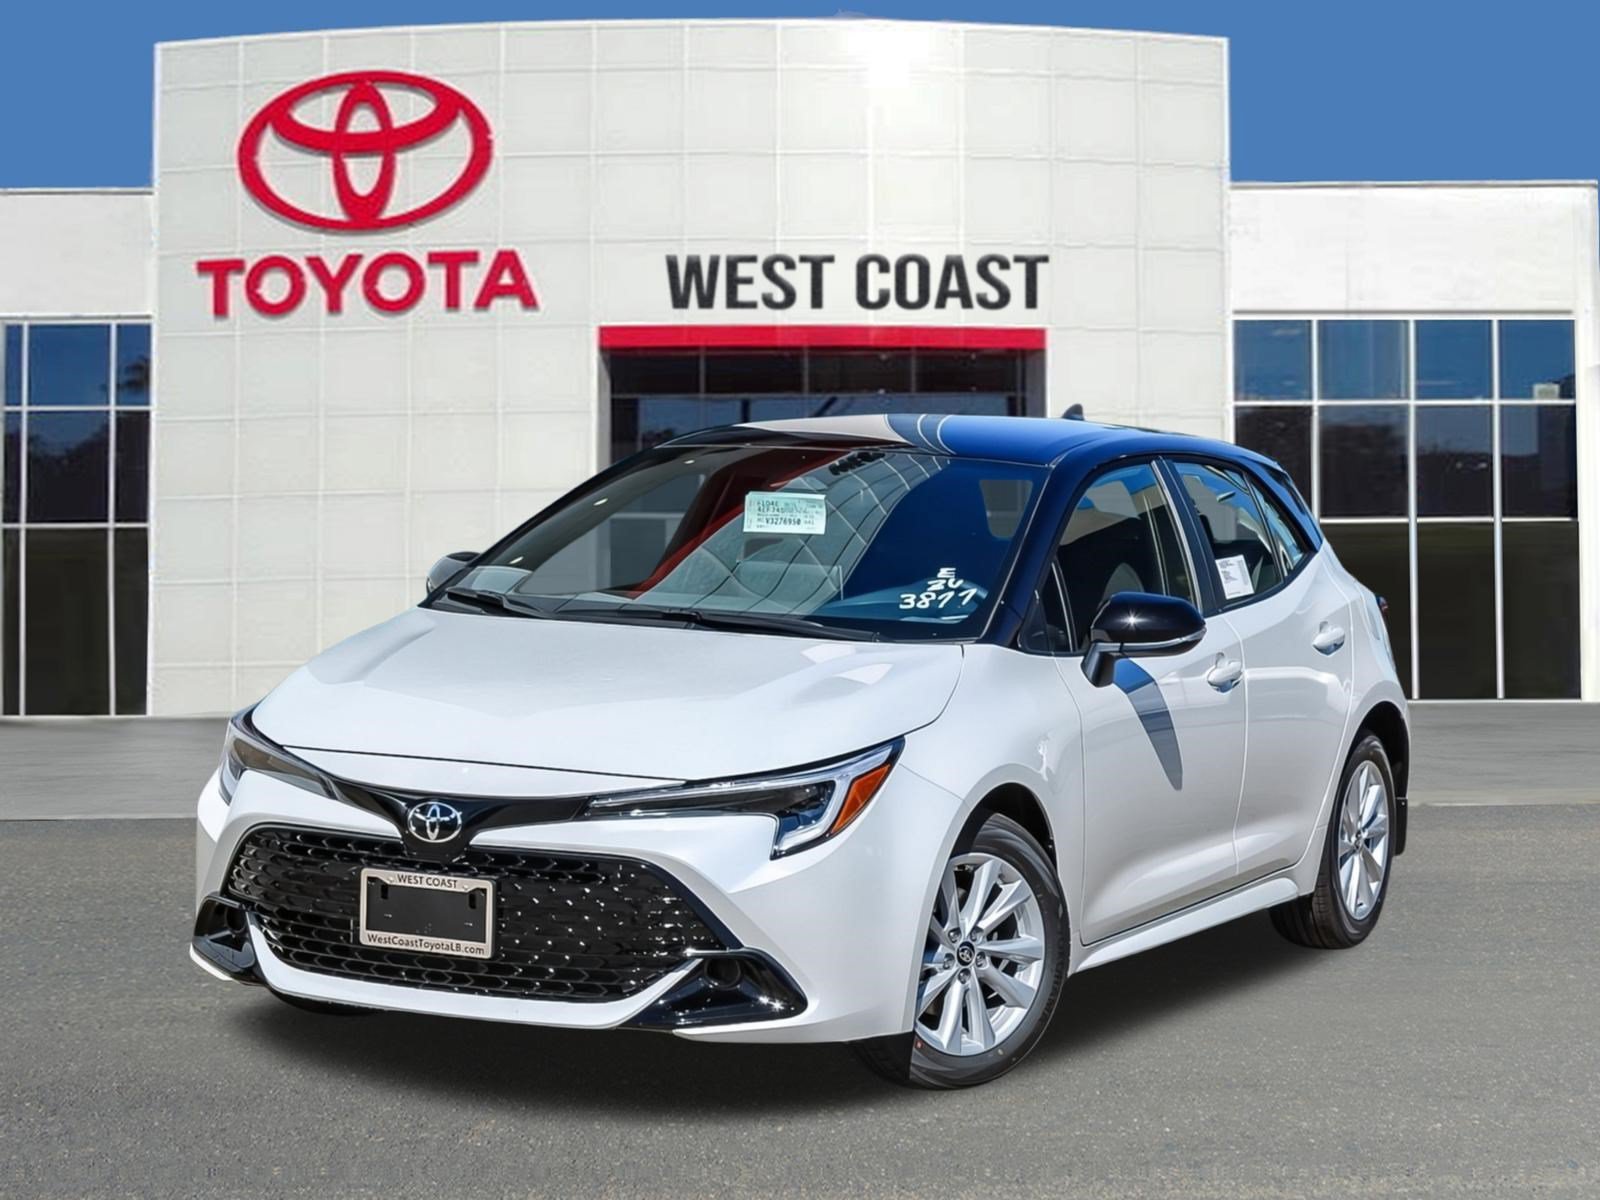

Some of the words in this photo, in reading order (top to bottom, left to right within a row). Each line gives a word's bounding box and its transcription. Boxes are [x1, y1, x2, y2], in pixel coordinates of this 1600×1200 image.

[196, 250, 539, 317] TOYOTA
[665, 253, 835, 310] WEST
[855, 253, 1049, 310] COAST
[397, 873, 423, 885] WEST
[425, 878, 458, 889] COAST
[367, 933, 485, 955] WestCoastToyotaLB.com
